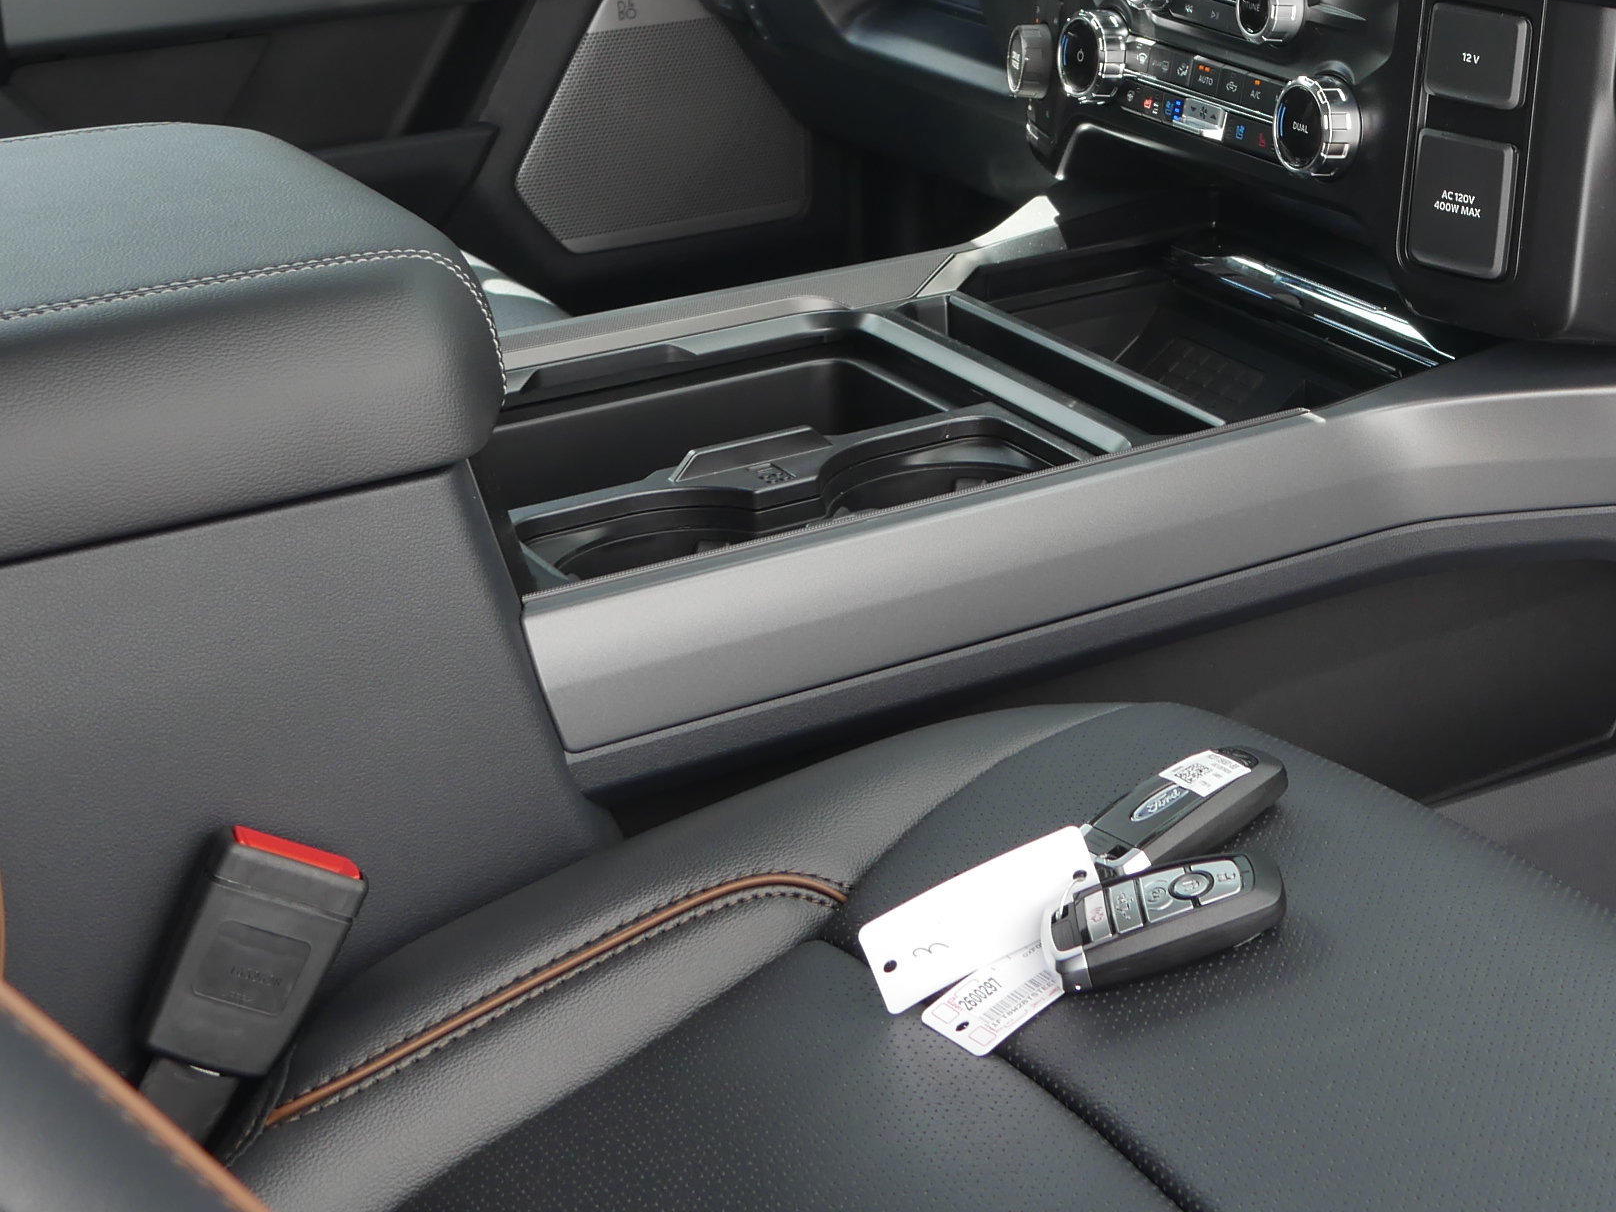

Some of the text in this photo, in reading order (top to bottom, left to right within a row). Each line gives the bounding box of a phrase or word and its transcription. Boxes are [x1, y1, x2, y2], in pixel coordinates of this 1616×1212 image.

[1462, 52, 1480, 64] 12 V
[1198, 75, 1213, 86] AUTO
[1250, 89, 1261, 100] A/C
[1292, 121, 1309, 134] DUAL
[1441, 190, 1476, 205] AC 120V
[1434, 200, 1481, 218] 400W MAX
[1146, 789, 1180, 813] Ford
[958, 977, 1003, 1011] 2600297
